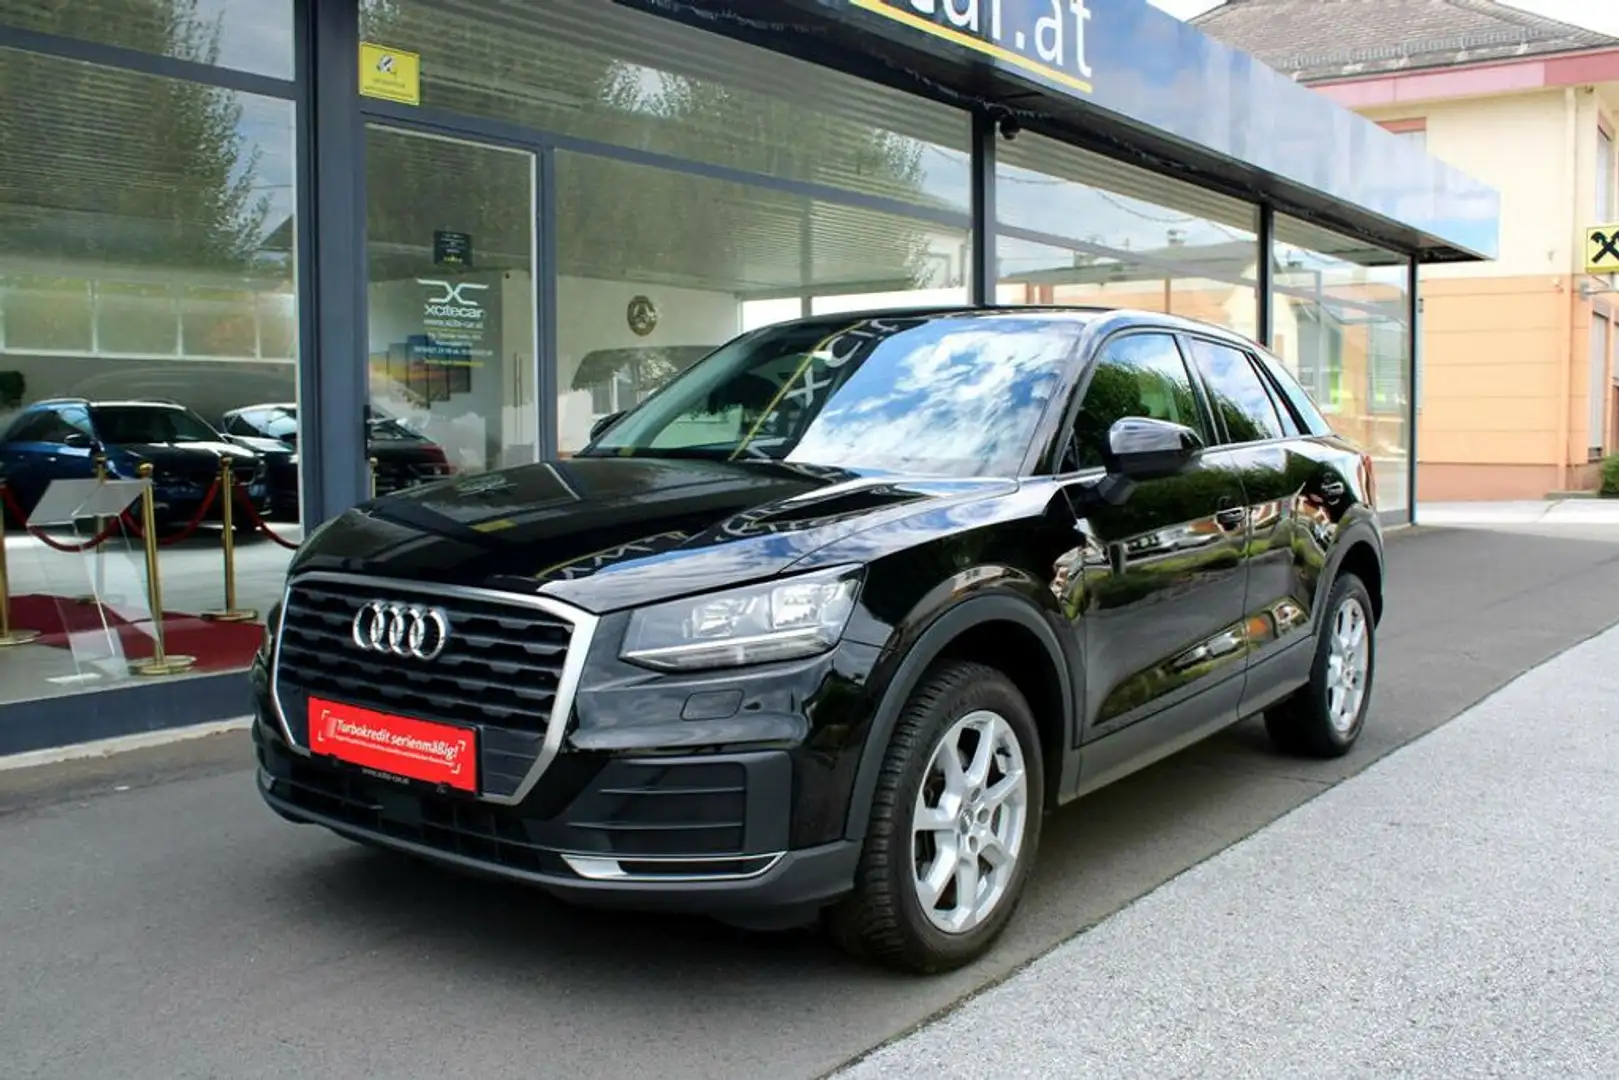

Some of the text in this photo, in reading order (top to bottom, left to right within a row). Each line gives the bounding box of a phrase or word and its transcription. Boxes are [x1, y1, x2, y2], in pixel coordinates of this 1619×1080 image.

[911, 0, 1092, 77] ar.at
[337, 719, 391, 744] Turbokredit
[391, 733, 460, 761] serienmäßig!
